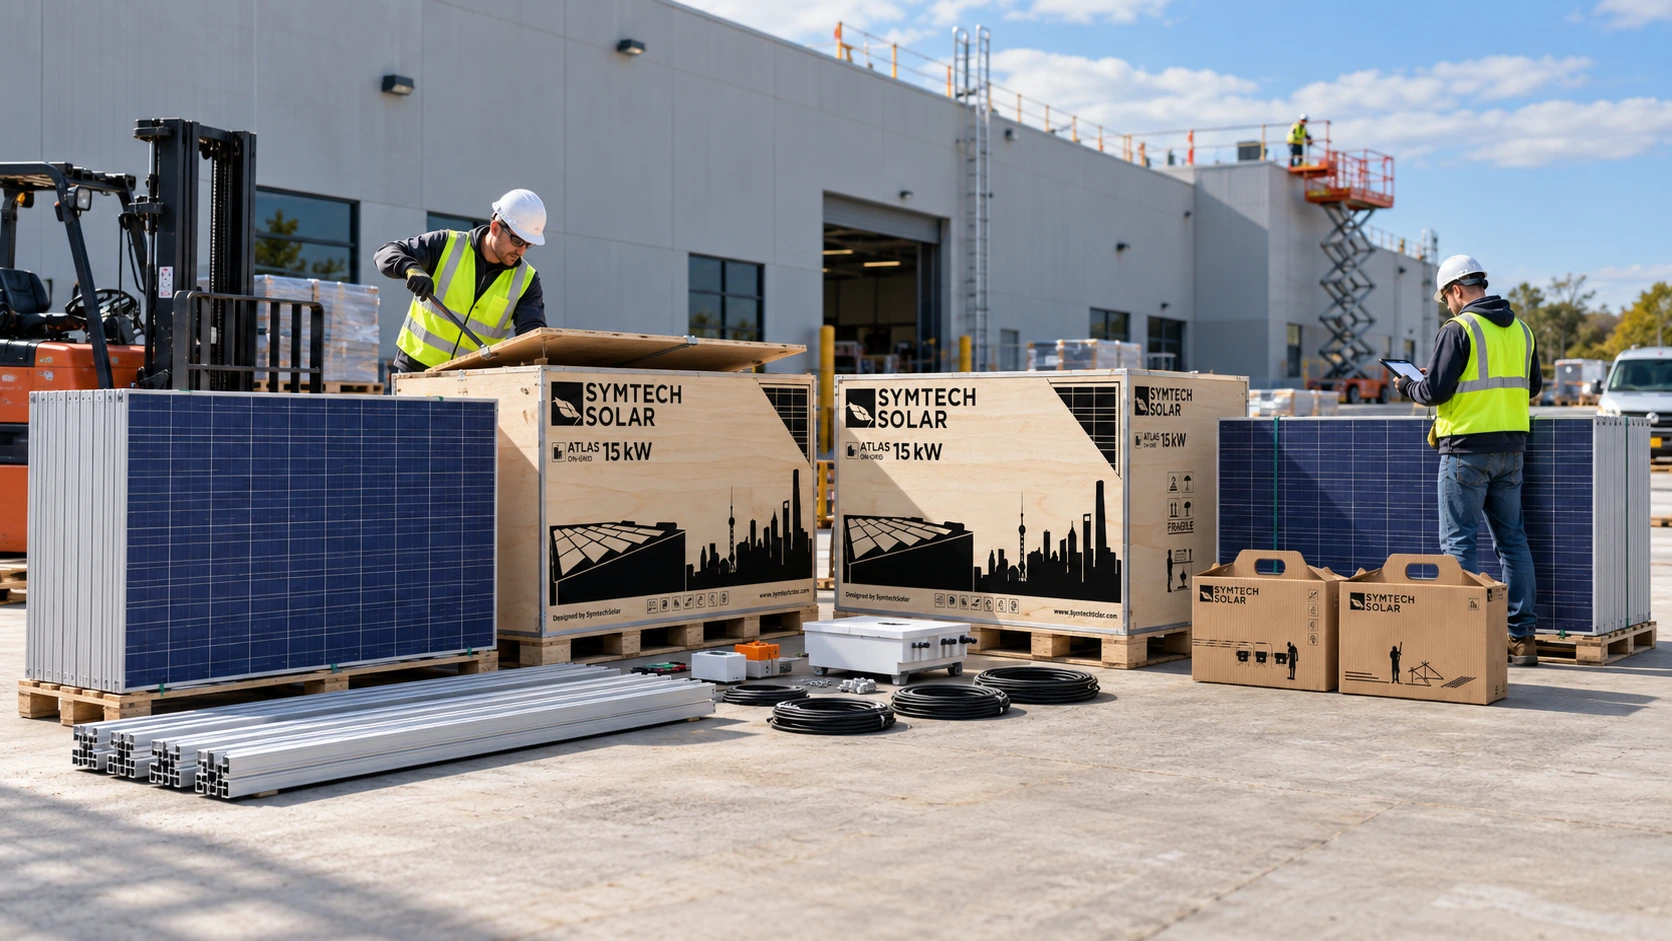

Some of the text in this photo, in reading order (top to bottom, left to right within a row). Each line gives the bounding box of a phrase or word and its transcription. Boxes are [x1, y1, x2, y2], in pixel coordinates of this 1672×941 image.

[585, 382, 682, 404] SYMTECH
[878, 387, 976, 407] SYMTECH
[1150, 387, 1193, 401] SYMTECH
[1150, 402, 1181, 416] SOLAR
[585, 406, 656, 427] SOLAR
[878, 410, 947, 429] SOLAR
[1143, 432, 1187, 448] ATLAS 15 kW
[567, 441, 653, 461] ATLAS 15 kW
[860, 441, 943, 461] ATLAS 15 kW
[1167, 521, 1194, 532] FRAGILE
[1214, 585, 1259, 596] SYMTECH
[1214, 595, 1246, 604] SOLAR
[1366, 593, 1415, 604] SYMTECH
[1366, 602, 1401, 613] SOLAR
[552, 611, 578, 622] Designed
[578, 611, 586, 620] by
